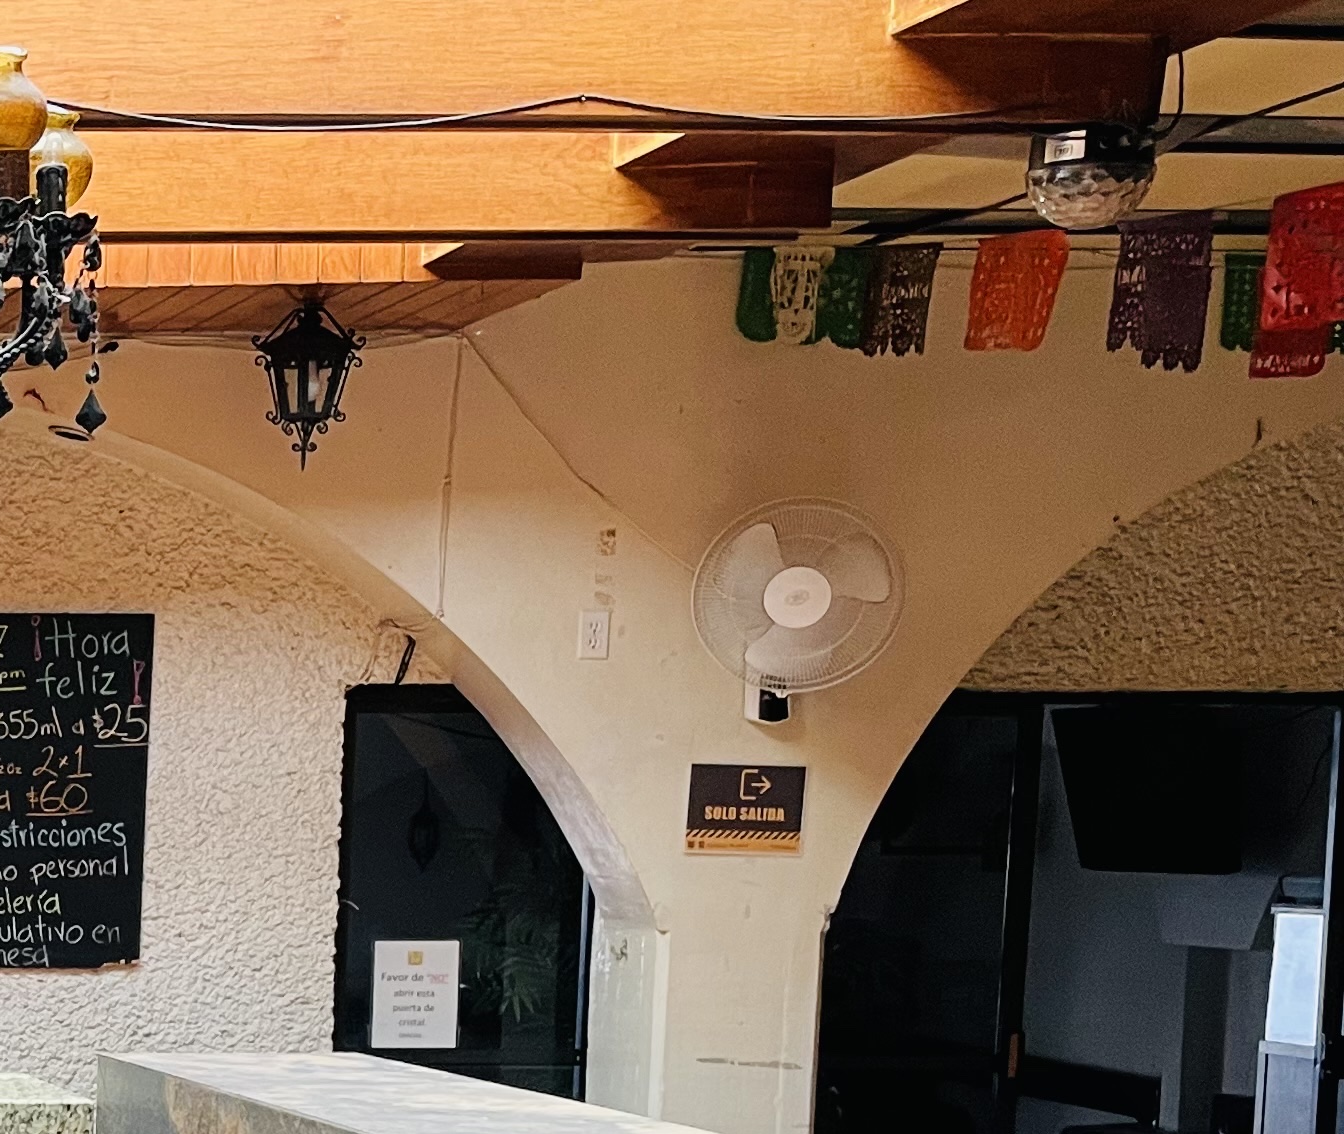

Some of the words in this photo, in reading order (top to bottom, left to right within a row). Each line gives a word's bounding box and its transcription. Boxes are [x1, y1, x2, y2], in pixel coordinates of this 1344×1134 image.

[71, 718, 85, 736] a
[92, 703, 148, 742] $25
[26, 780, 88, 812] $60
[704, 806, 737, 820] SOLO
[739, 807, 785, 822] SALIDA
[29, 845, 129, 886] personal
[91, 924, 121, 944] en
[381, 971, 409, 981] Favor
[411, 972, 424, 981] de
[393, 989, 414, 998] abrir
[416, 989, 435, 997] esta
[392, 1004, 422, 1013] puerta
[423, 1004, 434, 1012] de
